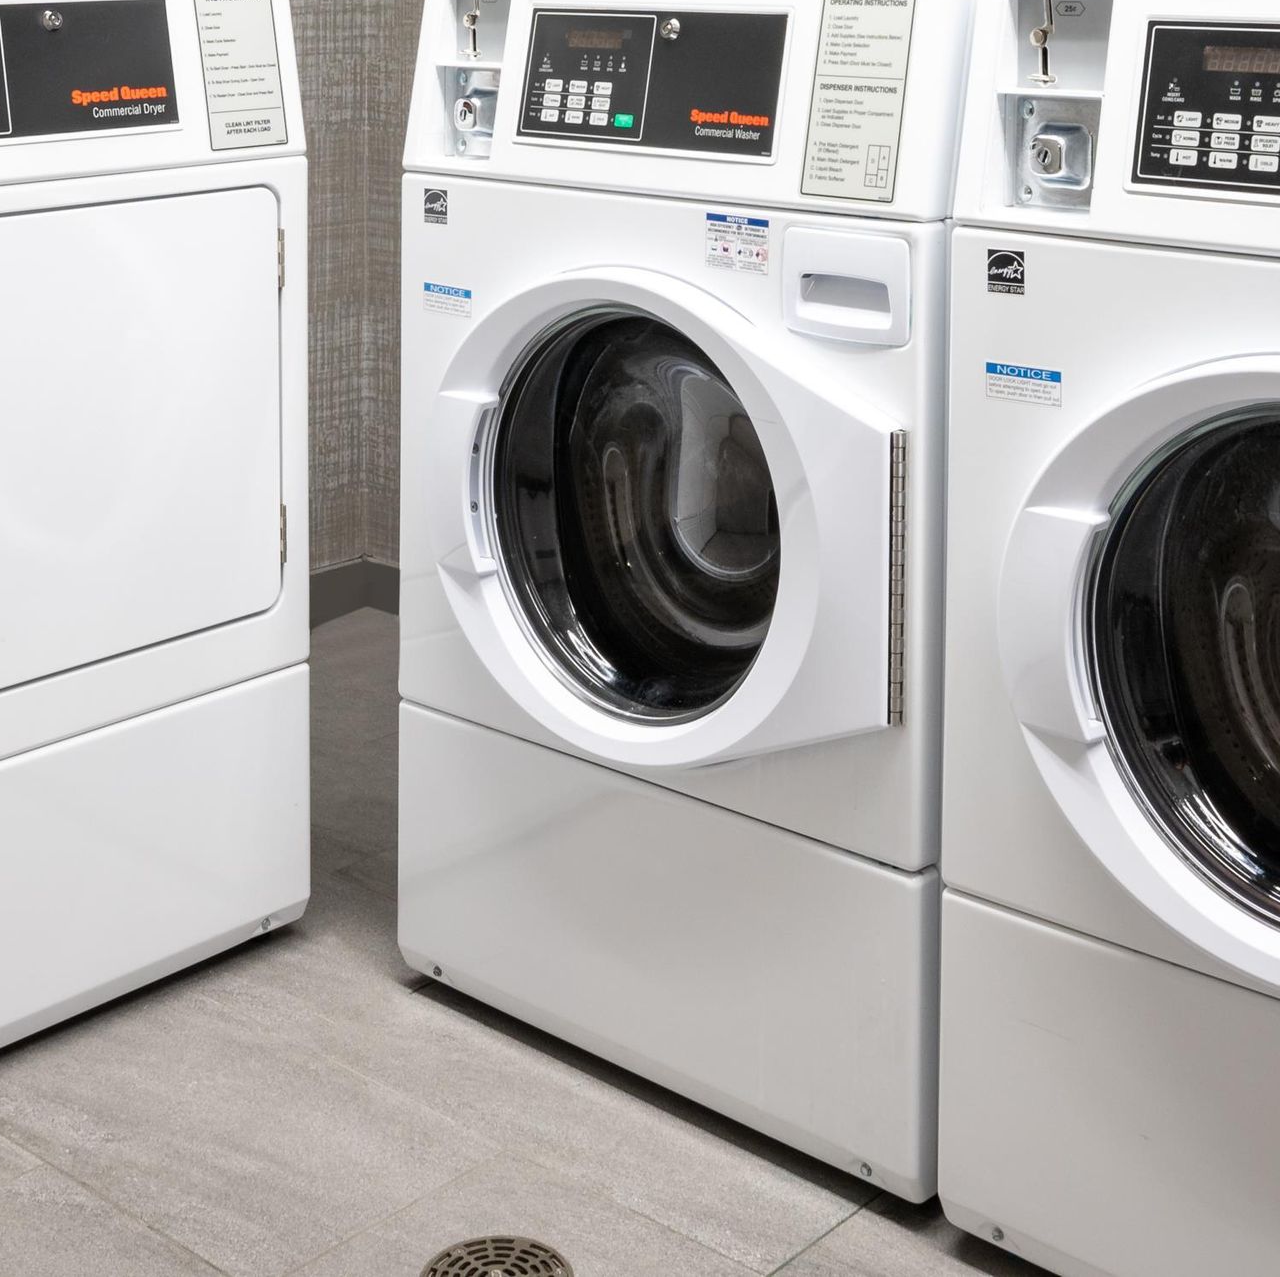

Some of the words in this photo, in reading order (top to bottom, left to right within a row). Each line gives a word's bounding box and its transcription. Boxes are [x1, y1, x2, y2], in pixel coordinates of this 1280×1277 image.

[71, 87, 119, 106] Speed
[121, 86, 167, 100] Queen
[820, 83, 852, 91] DISPENSER
[853, 85, 897, 94] INSTRUCTIONS
[92, 104, 142, 118] Commercial
[143, 103, 166, 116] Dryer
[690, 109, 728, 124] Speed
[729, 111, 769, 126] Queen
[695, 125, 734, 138] Commercial
[735, 129, 760, 140] Washer
[430, 284, 466, 297] NOTICE
[988, 284, 1009, 293] ENERGY
[1010, 286, 1024, 294] STAR
[996, 365, 1052, 381] NOTICE
